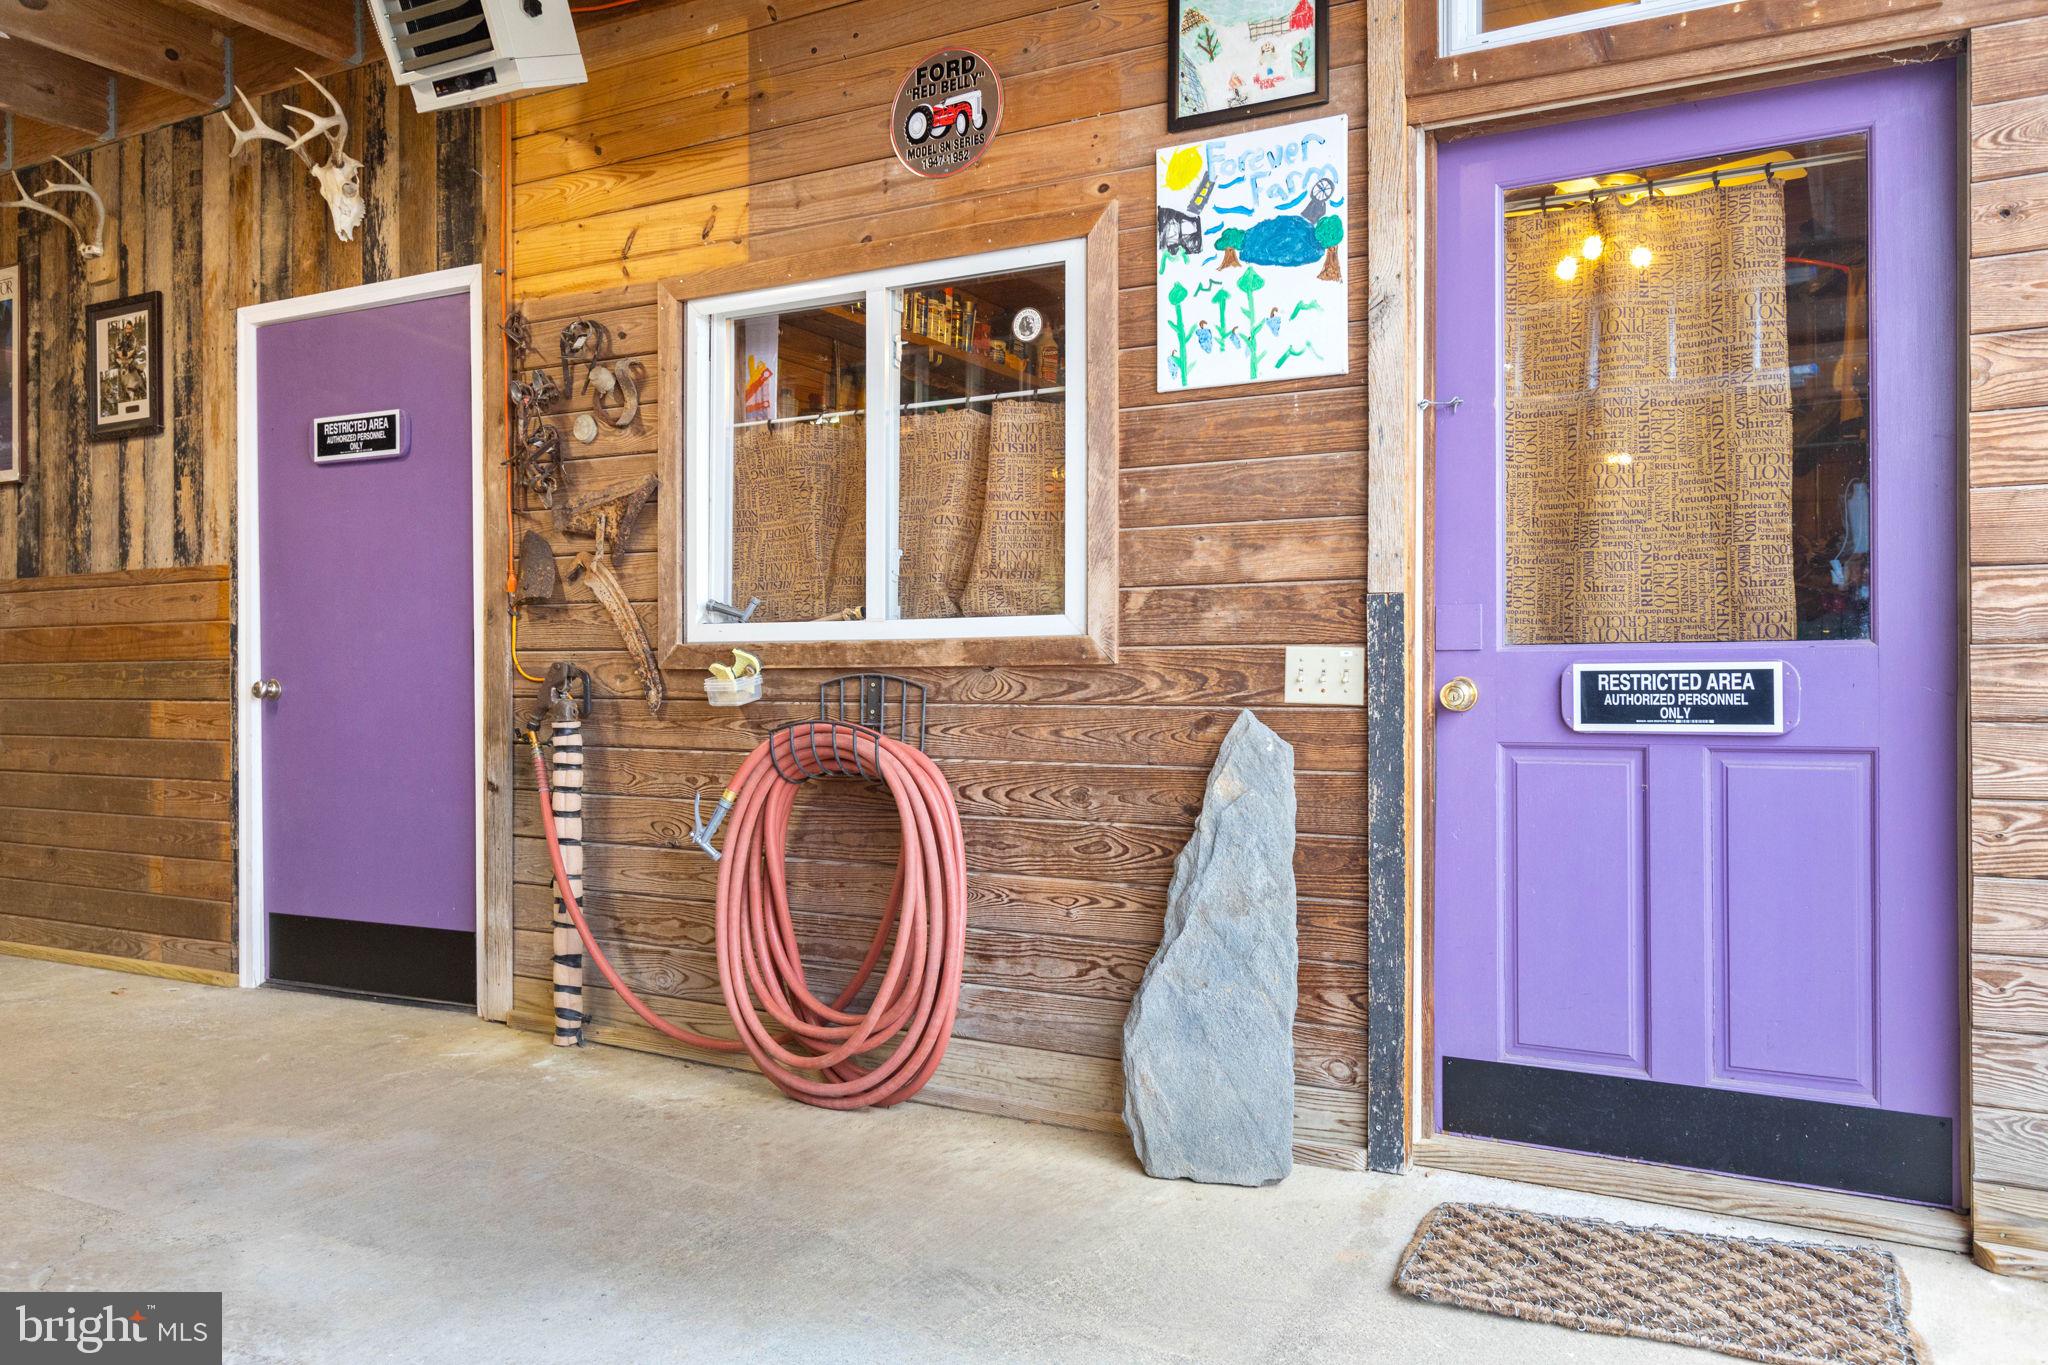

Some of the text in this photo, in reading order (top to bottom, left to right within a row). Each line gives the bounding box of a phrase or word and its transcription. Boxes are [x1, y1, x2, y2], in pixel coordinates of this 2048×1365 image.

[916, 55, 976, 86] FORD
[907, 146, 937, 160] MODEL
[954, 133, 985, 147] SERIES
[1205, 132, 1327, 182] Forever
[1250, 163, 1340, 207] Farm
[1739, 191, 1752, 222] NOIR
[1733, 257, 1779, 271] Shiraz
[1506, 251, 1517, 316] RIESLING
[1718, 345, 1729, 388] Shiraz
[1603, 396, 1634, 408] PINOT
[1650, 397, 1707, 409] Bordeaux
[1514, 409, 1564, 420] Bordeaux
[1602, 406, 1634, 419] NOIR
[324, 417, 389, 435] RESTRICTED AREA
[1639, 387, 1650, 454] RIESLING
[1736, 417, 1784, 431] Shiraz
[326, 431, 387, 444] AUTHORIZED PERSONNEL
[349, 442, 364, 450] ONLY
[1679, 492, 1739, 504] Chardonnay
[1671, 510, 1726, 523] RIESLING
[1721, 503, 1733, 546] Shiraz
[1732, 511, 1745, 544] PINOT
[1744, 509, 1757, 542] NOIR
[1589, 518, 1600, 549] NOIR
[1513, 555, 1561, 566] Bordeaux
[1603, 550, 1634, 562] PINOT
[1652, 552, 1710, 562] Bordeaux
[1604, 560, 1634, 573] NOIR
[1639, 542, 1652, 608] RIESLING
[1739, 575, 1786, 588] Shiraz
[1523, 566, 1537, 608] PINOT
[1582, 580, 1626, 594] Shiraz
[1664, 562, 1680, 608] PINOT
[1514, 617, 1551, 626] RIESLING
[1656, 616, 1698, 625] RIESLING
[1597, 627, 1650, 643] PINOT
[1598, 672, 1755, 691] RESTRICTED AREA
[1604, 692, 1749, 706] AUTHORIZED PERSONNEL
[1660, 706, 1691, 719] ONLY
